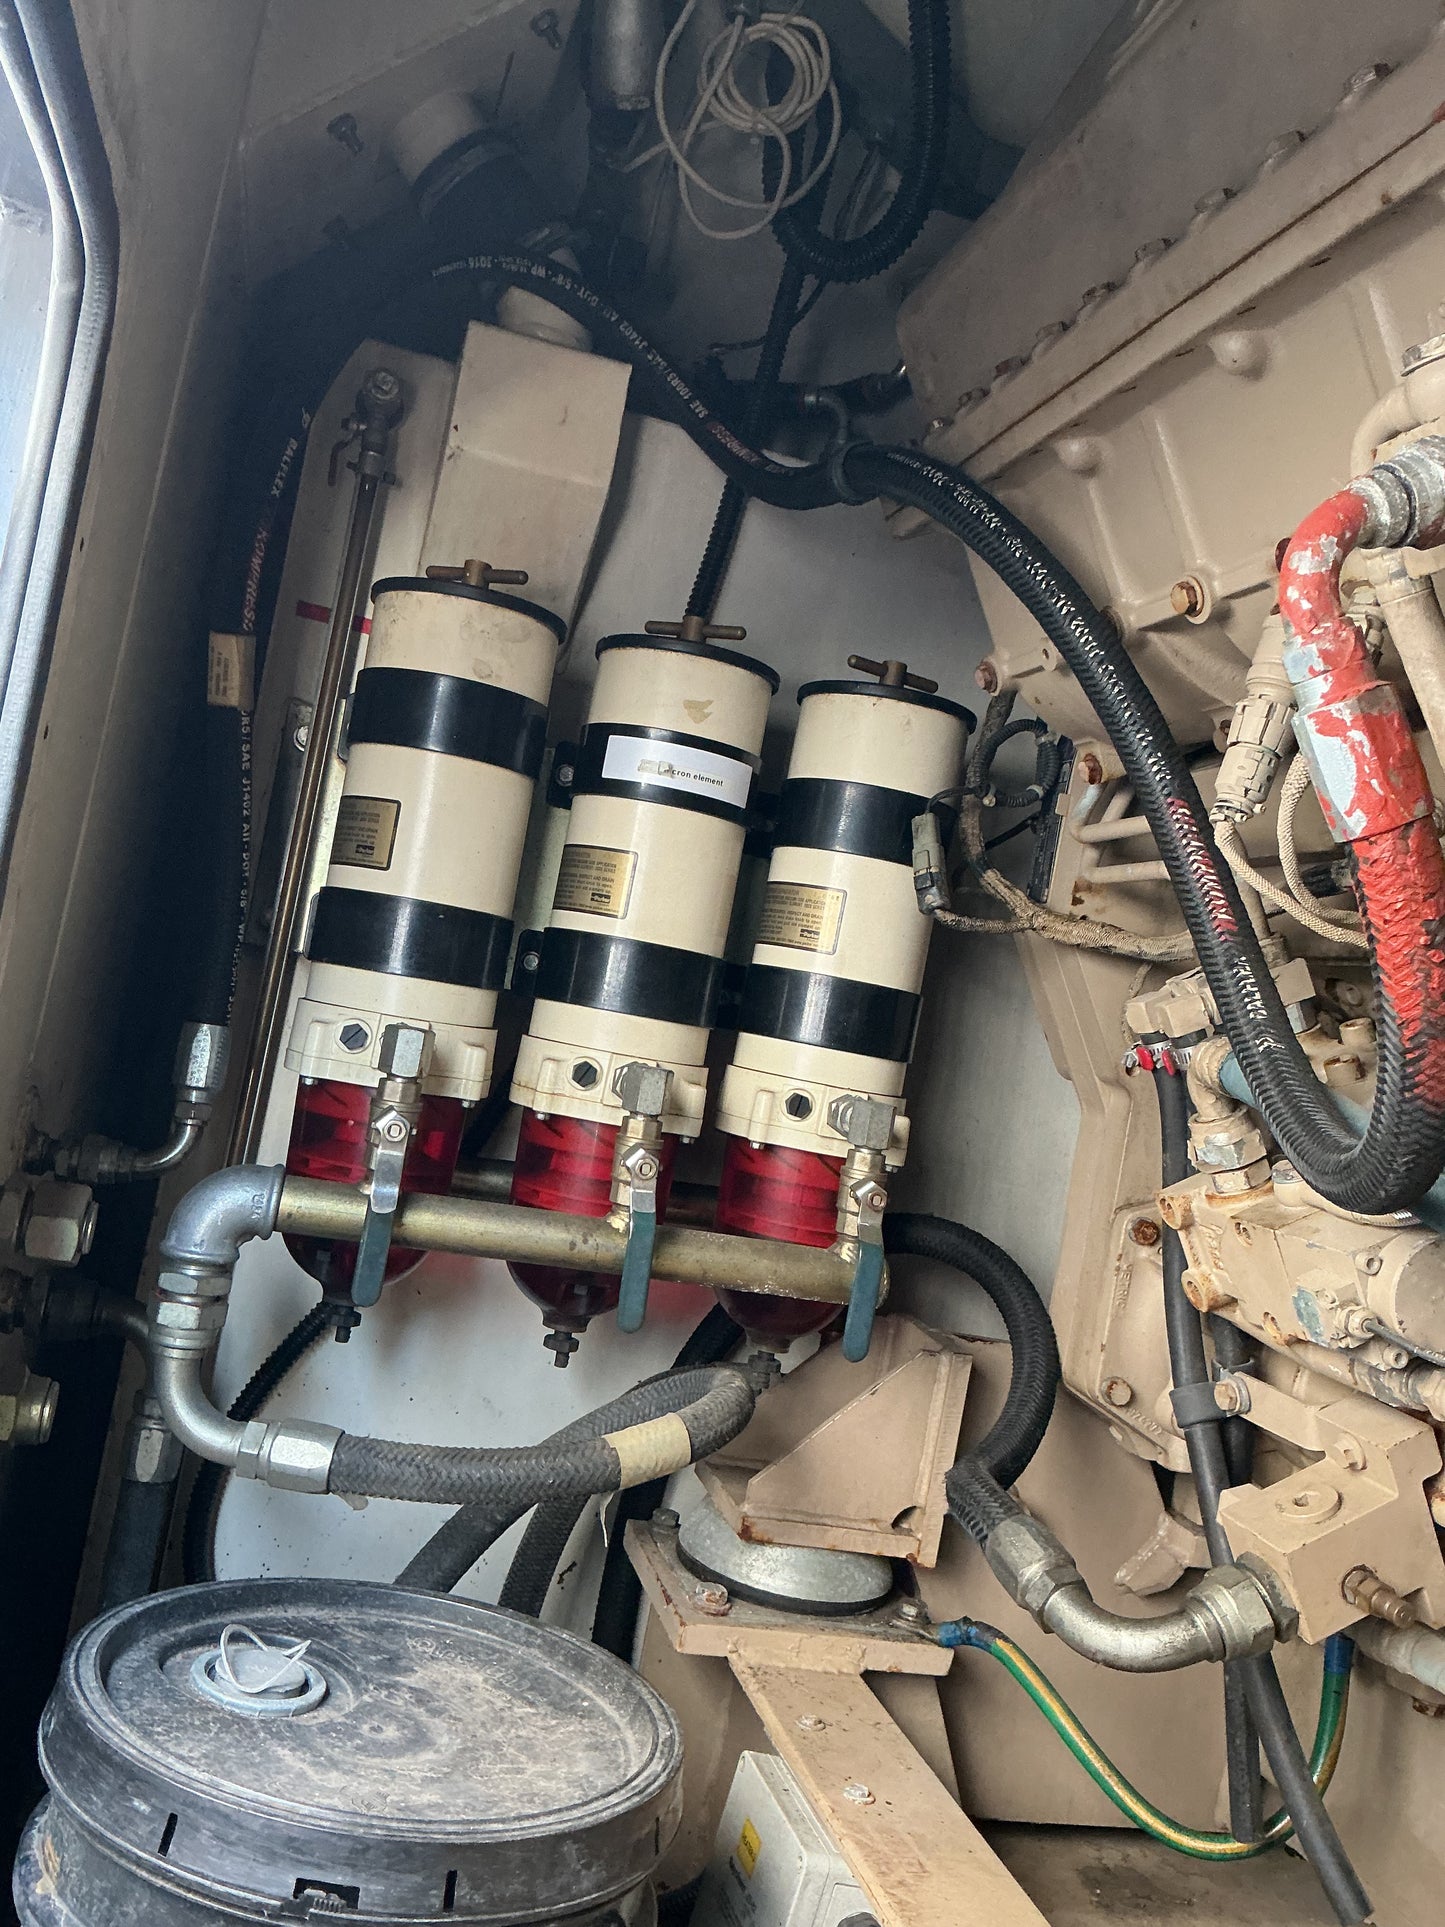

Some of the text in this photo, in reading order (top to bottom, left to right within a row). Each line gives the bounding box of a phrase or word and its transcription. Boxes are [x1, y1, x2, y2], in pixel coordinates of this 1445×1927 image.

[620, 320, 648, 349] J1402
[271, 437, 298, 499] BALFLEX
[241, 743, 250, 771] SAE
[693, 773, 724, 787] element
[241, 777, 250, 818] J1402
